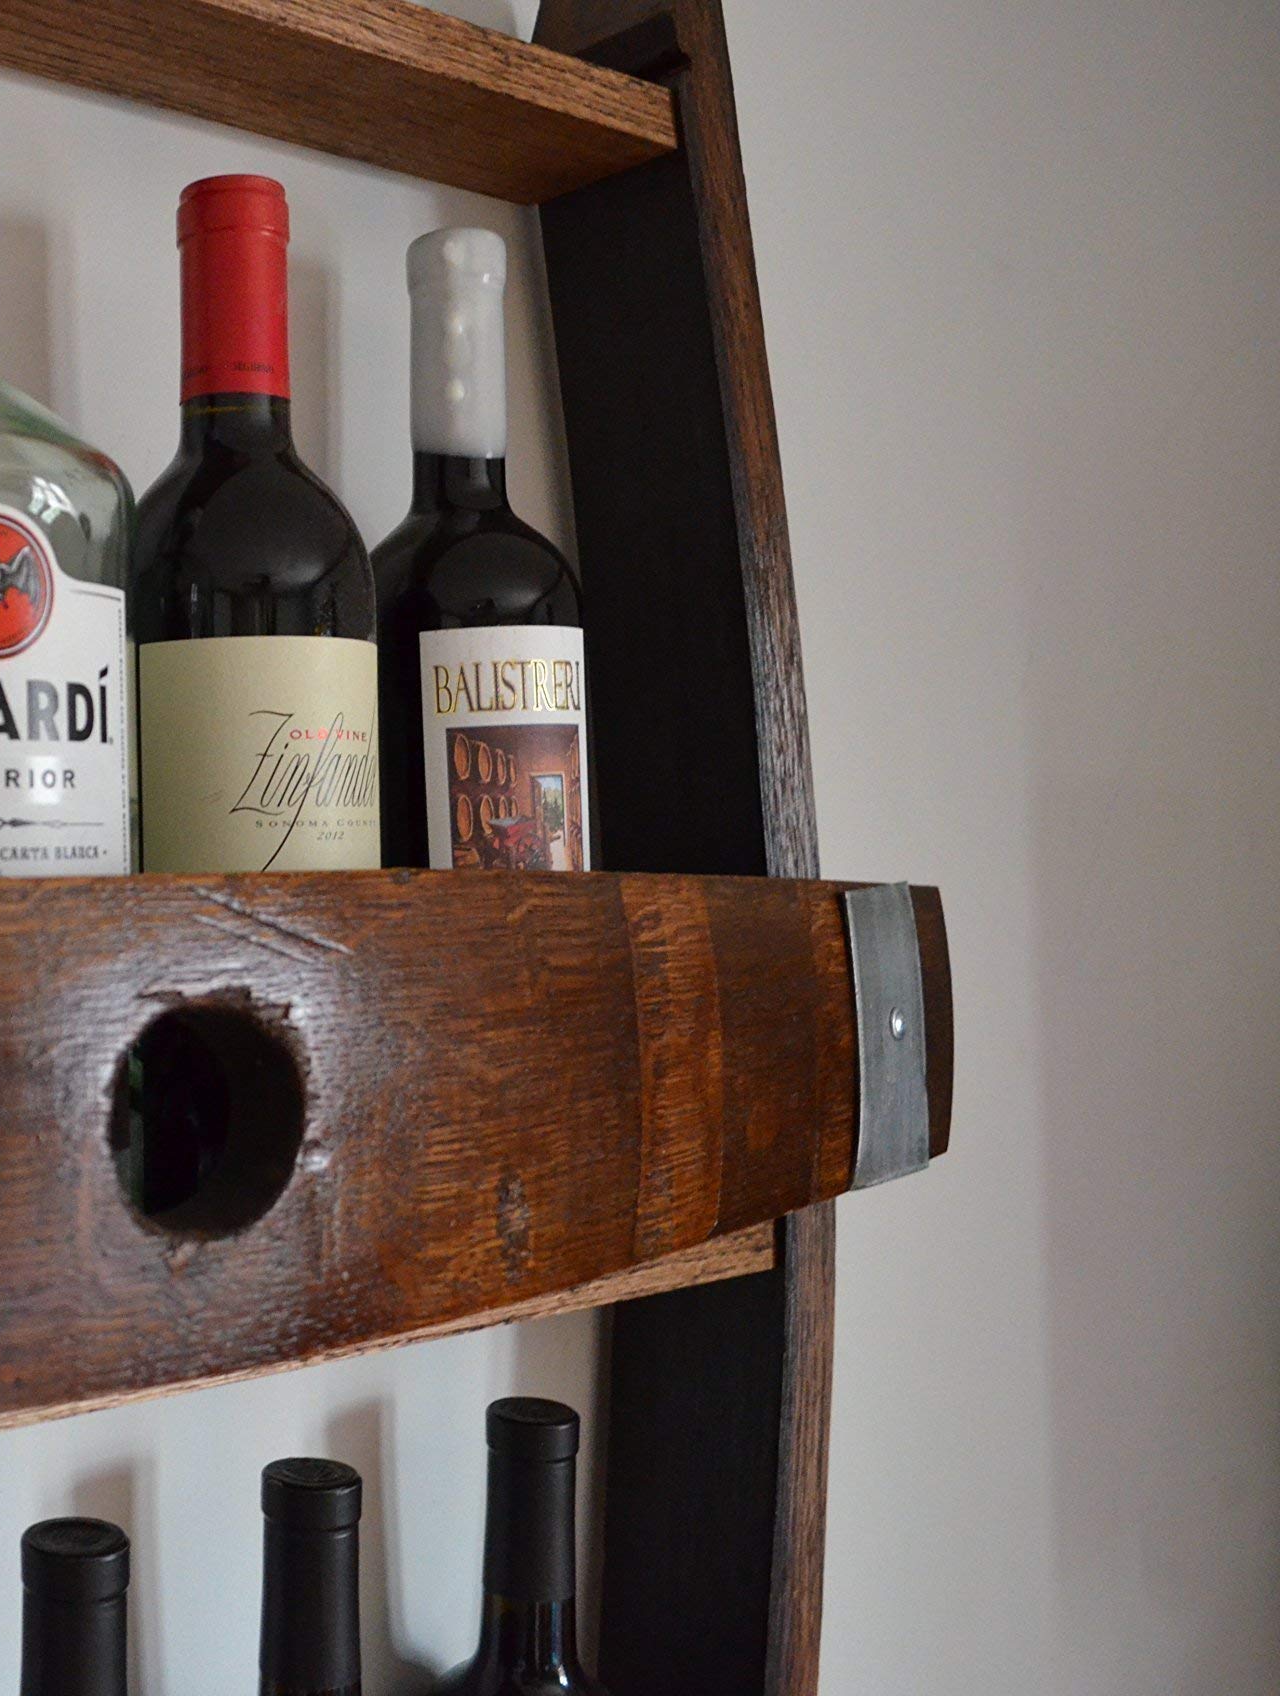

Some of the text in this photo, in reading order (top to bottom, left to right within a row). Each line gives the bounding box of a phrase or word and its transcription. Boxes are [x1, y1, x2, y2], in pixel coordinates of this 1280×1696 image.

[434, 658, 581, 714] BALISTRERI
[289, 728, 368, 743] OLD VINE
[255, 820, 329, 828] SONOMA
[316, 831, 345, 841] 2012
[0, 847, 48, 862] CARTA
